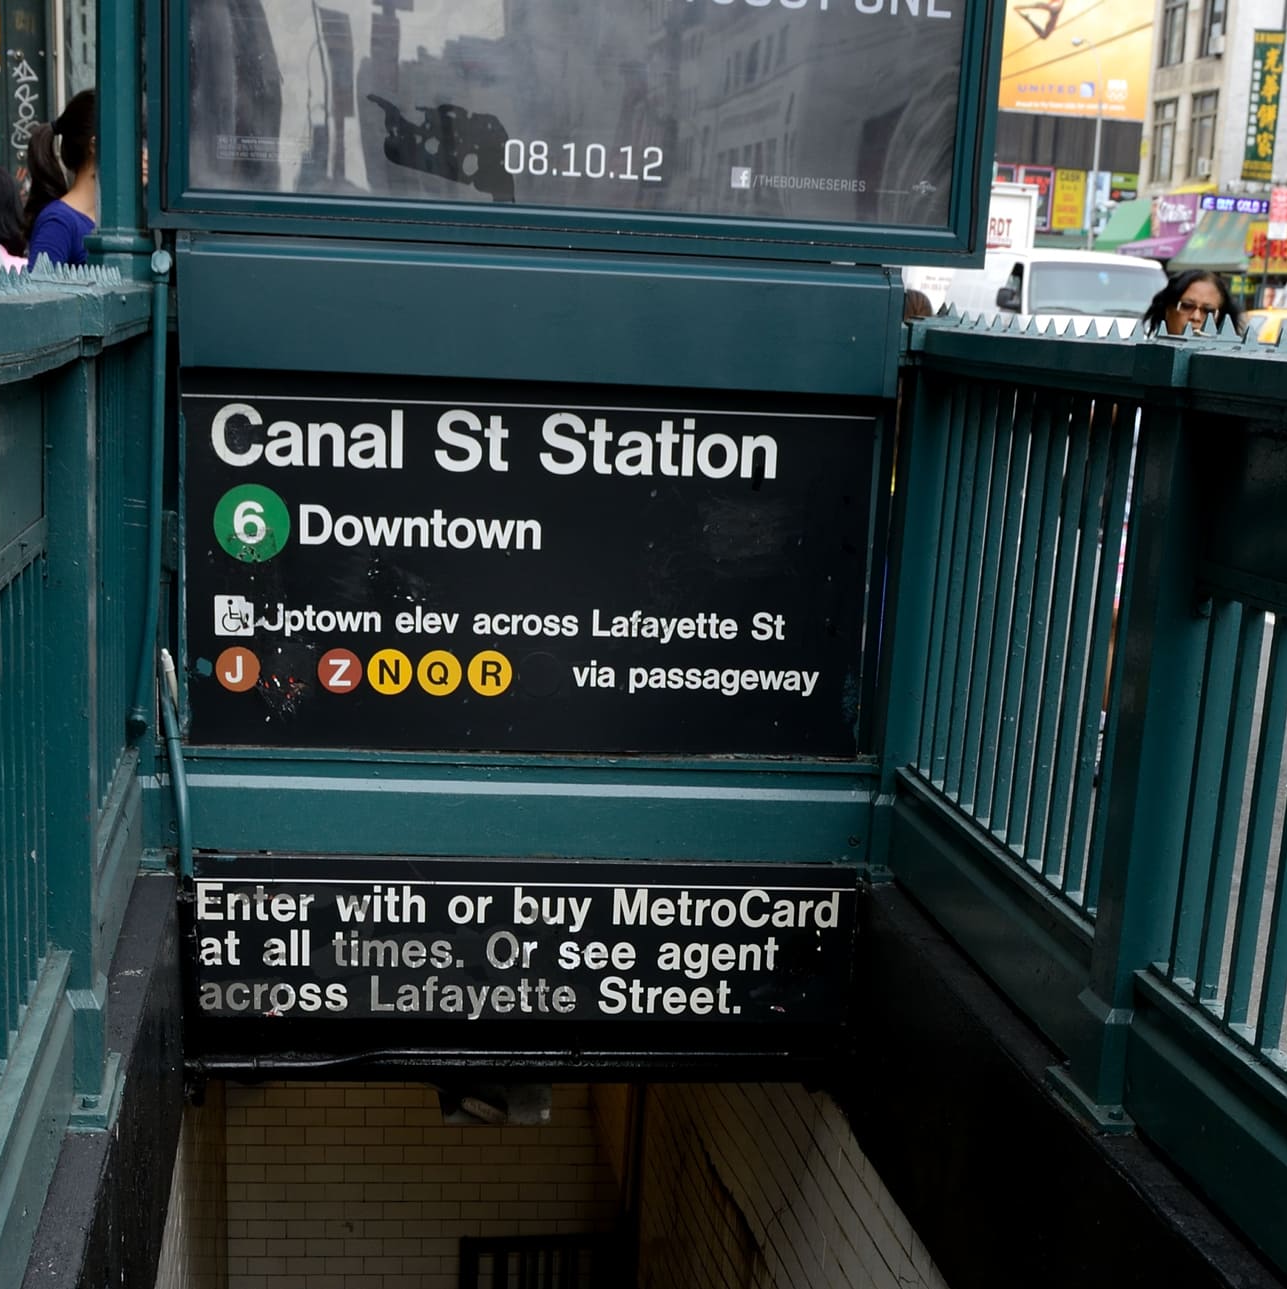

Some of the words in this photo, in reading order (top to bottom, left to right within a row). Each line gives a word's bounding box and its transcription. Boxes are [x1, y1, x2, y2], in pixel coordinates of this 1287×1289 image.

[1017, 83, 1077, 94] UNITED
[503, 138, 664, 182] 08.10.12
[989, 217, 1012, 237] RDT
[1236, 199, 1261, 213] GOLD
[211, 403, 405, 469] Canal
[434, 409, 510, 473] St
[539, 412, 779, 480] Station
[299, 504, 542, 551] Downtown
[395, 605, 460, 634] elev
[472, 611, 579, 636] across
[592, 608, 739, 644] Lafayette
[751, 611, 785, 641] St
[573, 660, 616, 689] via
[628, 666, 820, 697] passageway
[196, 882, 315, 922] Enter
[335, 885, 426, 923] with
[447, 894, 493, 925] or
[513, 887, 592, 933] buy
[612, 888, 840, 928] MetroCard
[199, 930, 241, 967] at
[262, 928, 311, 967] all
[332, 930, 465, 969] times.
[486, 930, 538, 970] Or
[558, 938, 636, 971] see
[657, 936, 780, 980] agent
[199, 981, 349, 1012] across
[370, 975, 577, 1020] Lafayette
[598, 976, 742, 1015] Street.
